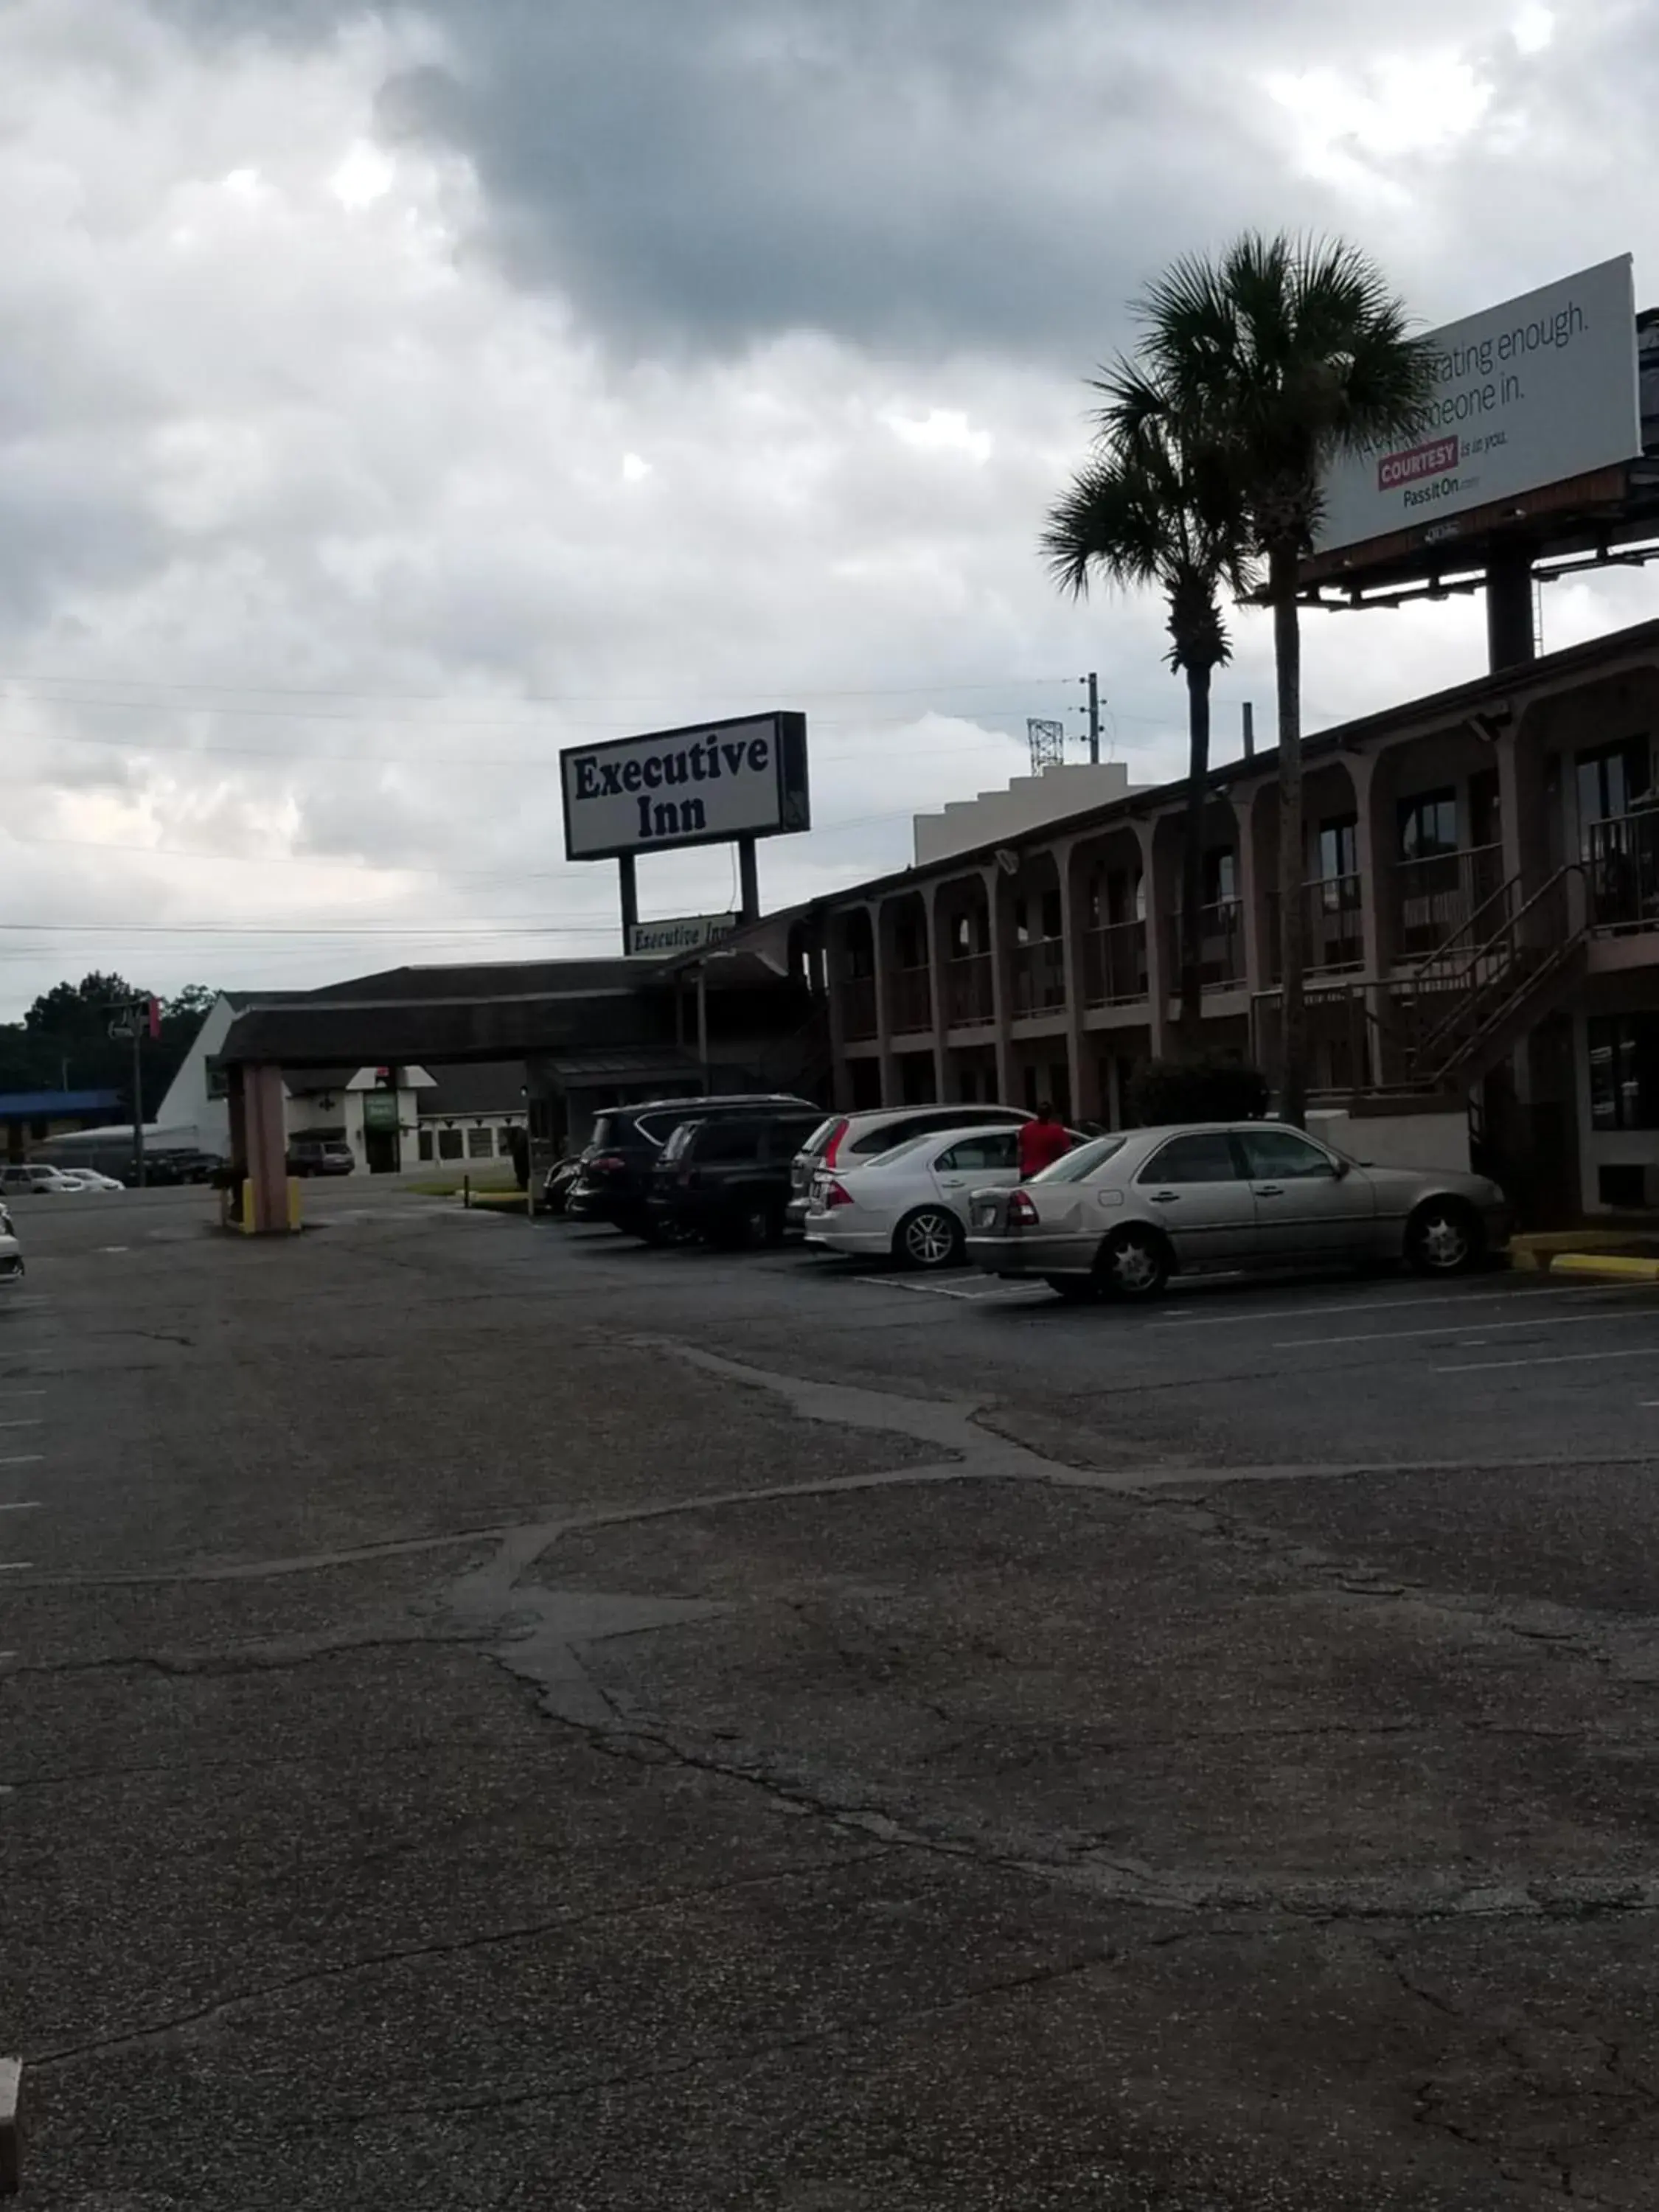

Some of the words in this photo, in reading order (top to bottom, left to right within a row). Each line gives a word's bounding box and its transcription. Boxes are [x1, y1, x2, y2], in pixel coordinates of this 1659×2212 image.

[1498, 301, 1590, 361] enough.
[1500, 372, 1525, 405] in.
[1381, 442, 1455, 484] COURTESY
[573, 734, 768, 800] Executive
[637, 795, 706, 838] Inn
[634, 925, 700, 952] Executive
